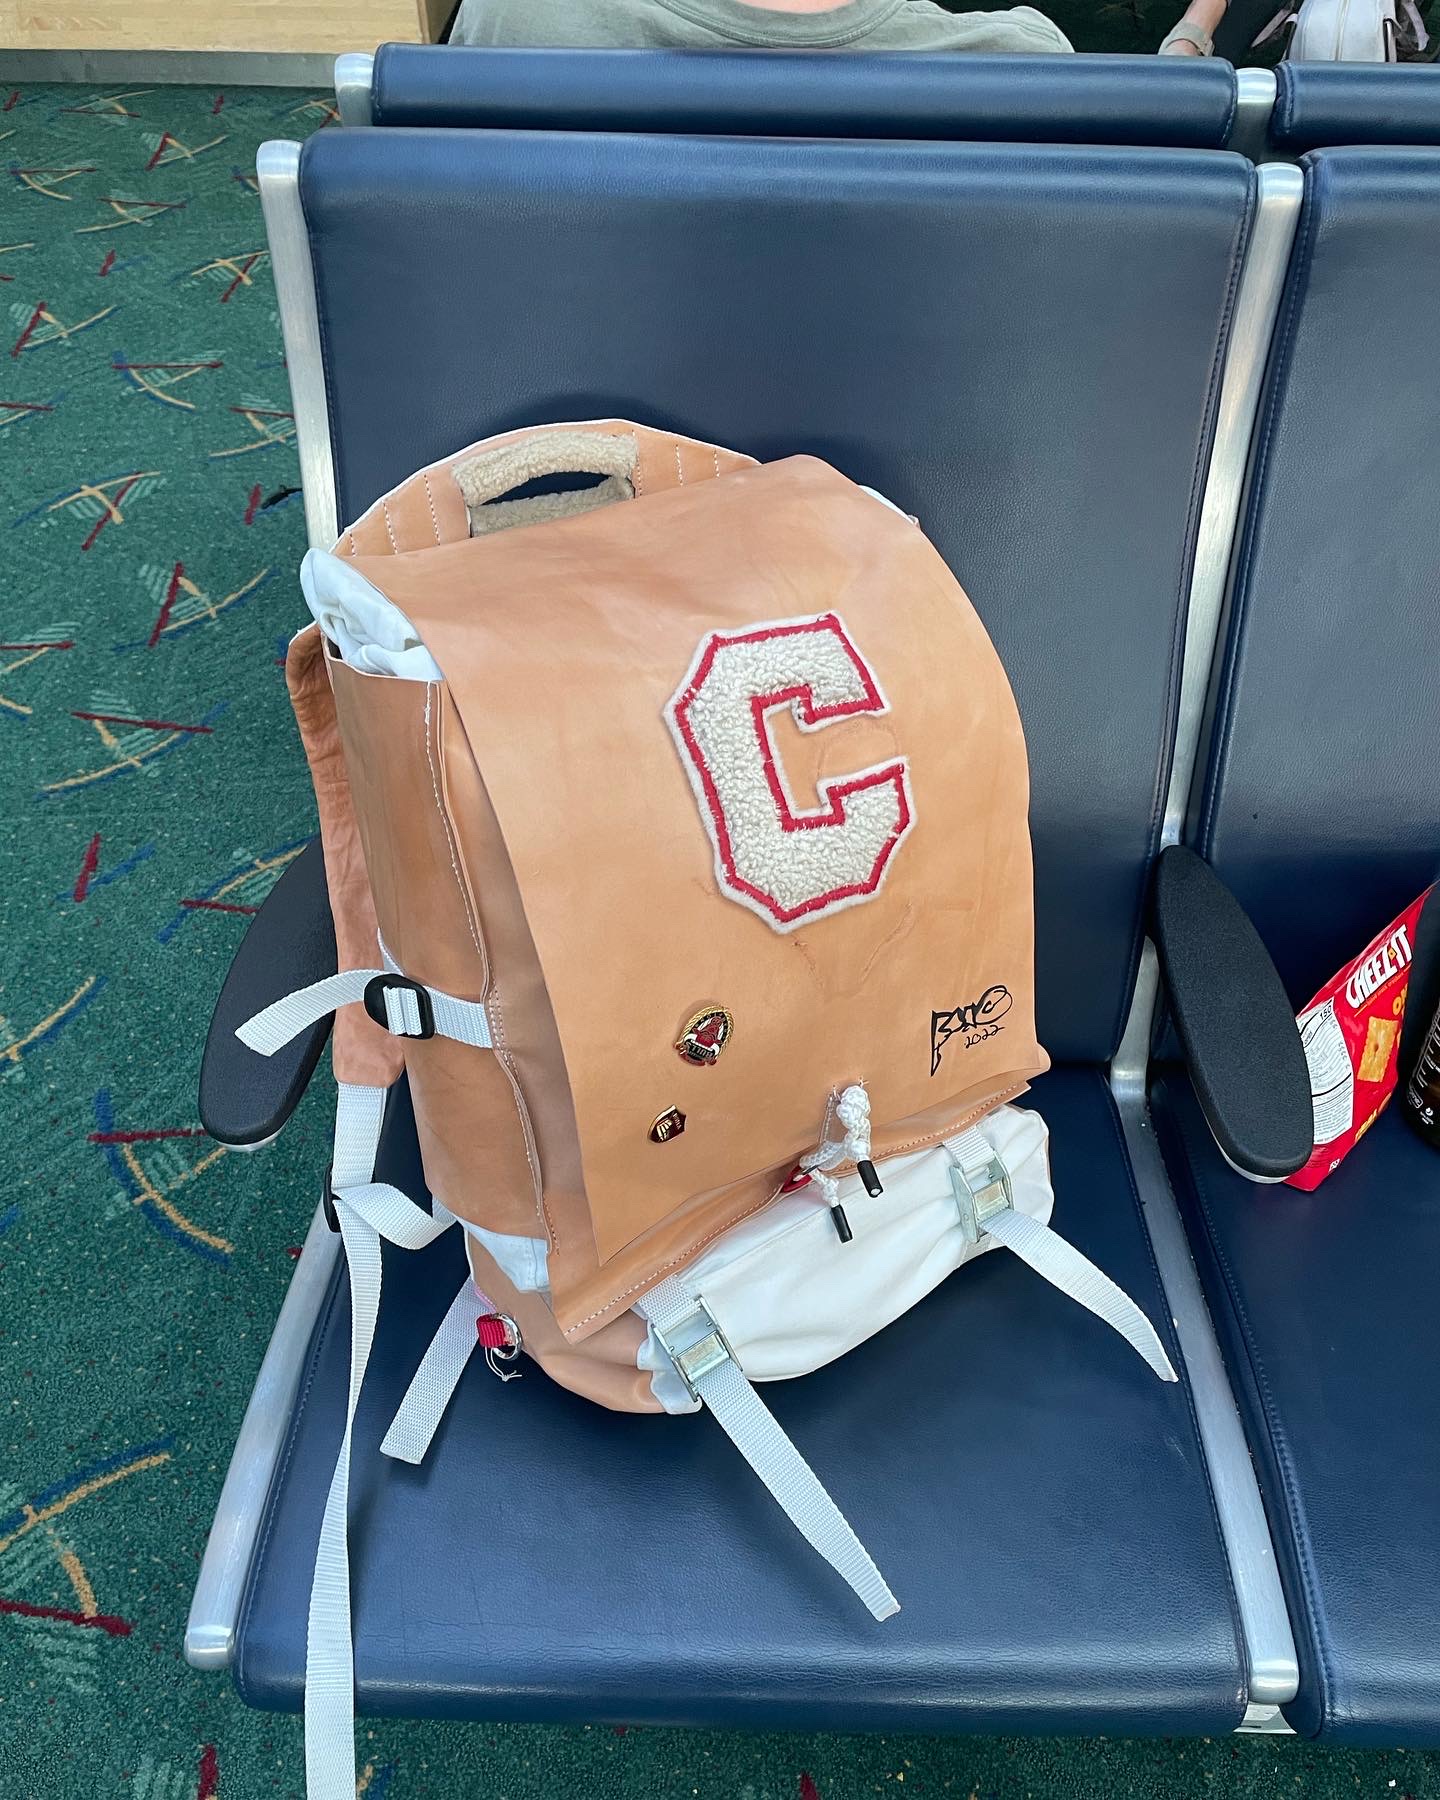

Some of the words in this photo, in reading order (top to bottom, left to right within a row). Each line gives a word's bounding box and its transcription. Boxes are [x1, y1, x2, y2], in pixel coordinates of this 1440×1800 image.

[664, 610, 917, 934] C
[1319, 1005, 1332, 1020] 150
[964, 1024, 1006, 1049] 2022
